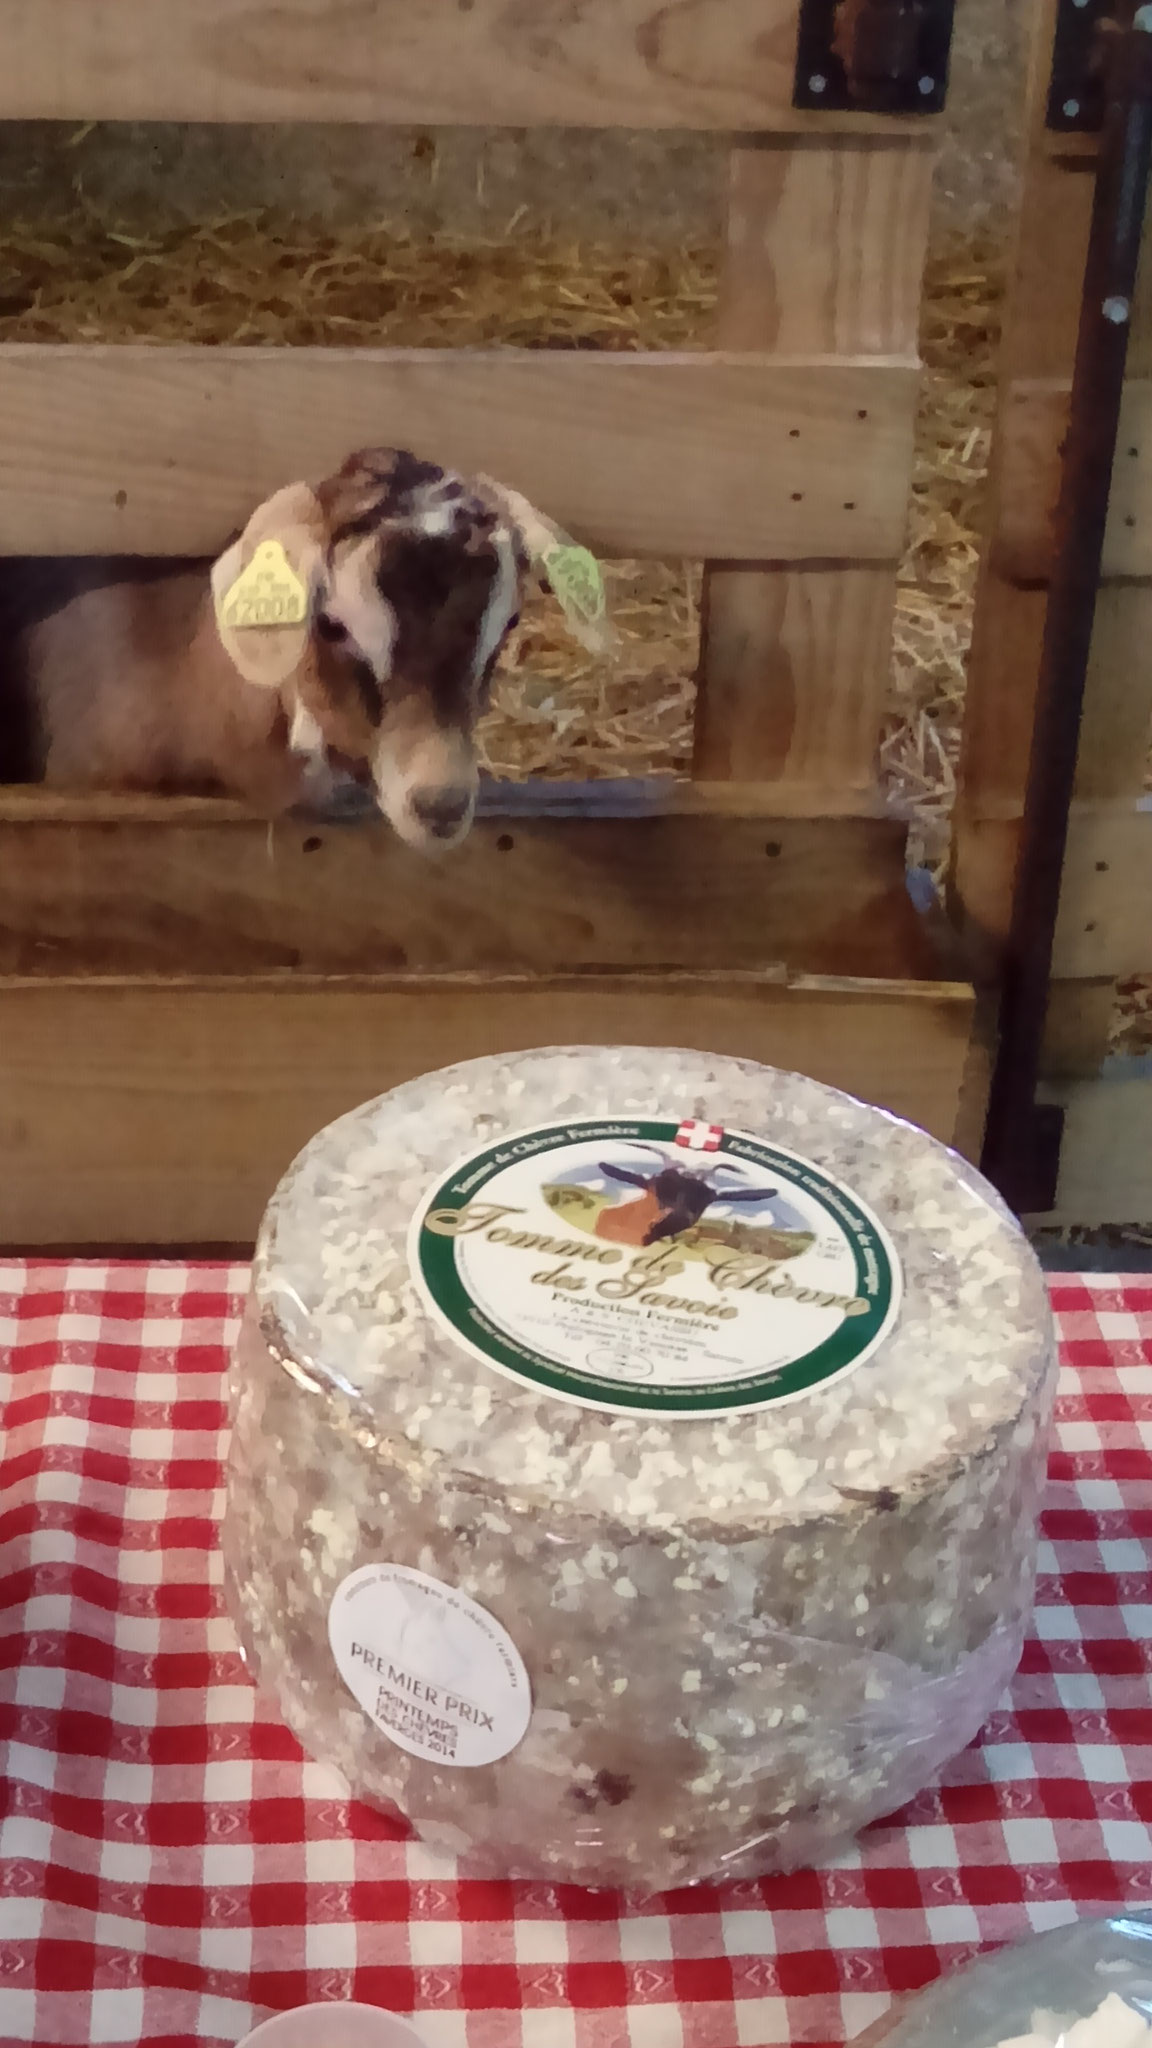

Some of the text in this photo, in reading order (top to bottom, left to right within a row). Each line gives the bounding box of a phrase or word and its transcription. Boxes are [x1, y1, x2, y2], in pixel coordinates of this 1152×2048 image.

[424, 1203, 625, 1266] Tomme
[630, 1245, 686, 1279] de
[704, 1252, 872, 1318] Chèvre
[530, 1262, 739, 1320] des Savoie
[552, 1292, 640, 1317] Production
[351, 1641, 495, 1733] PREMIER PRIX
[379, 1685, 458, 1737] PRINTEMPS
[426, 1739, 456, 1760] 2014
